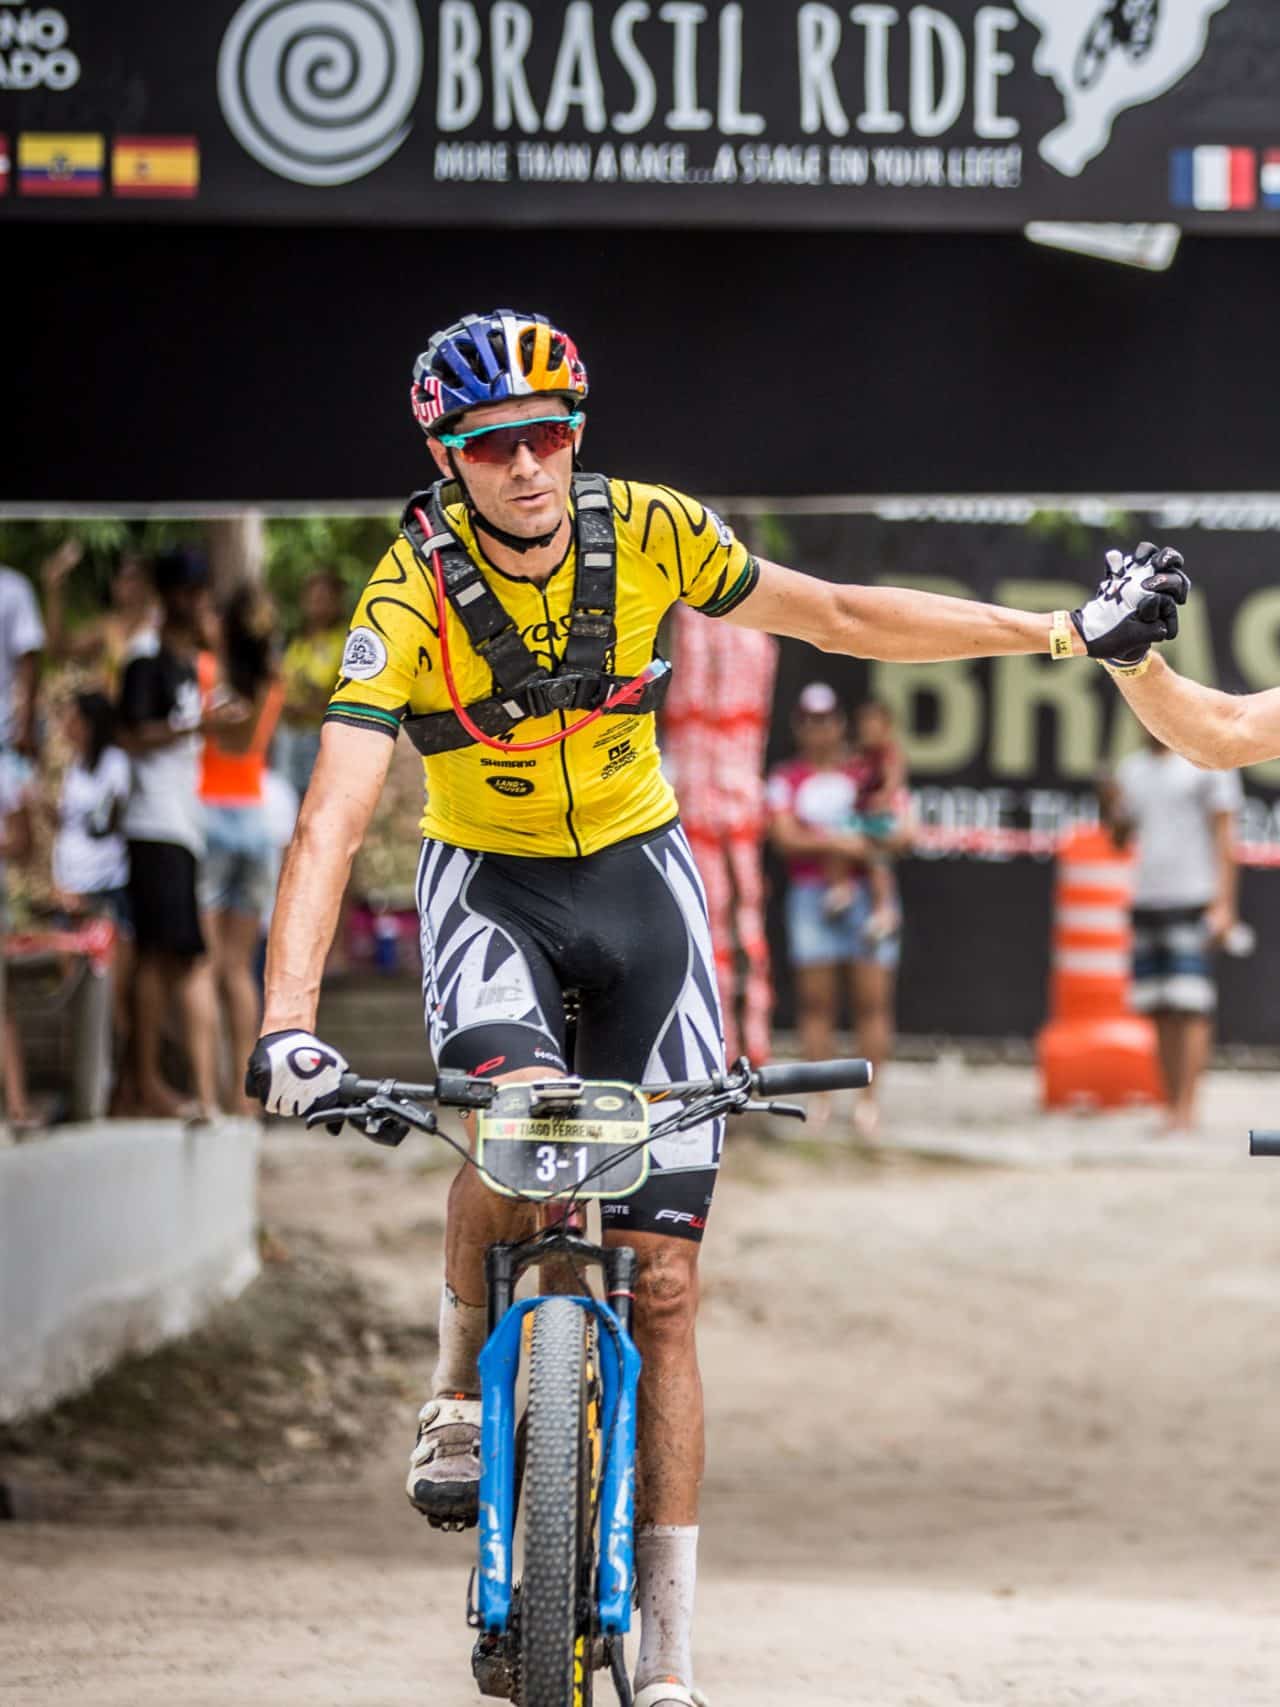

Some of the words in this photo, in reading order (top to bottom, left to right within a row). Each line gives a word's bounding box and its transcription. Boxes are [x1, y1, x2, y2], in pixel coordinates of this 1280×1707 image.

[436, 0, 766, 134] BRASIL
[799, 4, 1020, 138] RIDE
[480, 758, 537, 769] SHIMANO
[520, 1122, 550, 1136] TIAGO
[536, 1145, 588, 1182] 3-1
